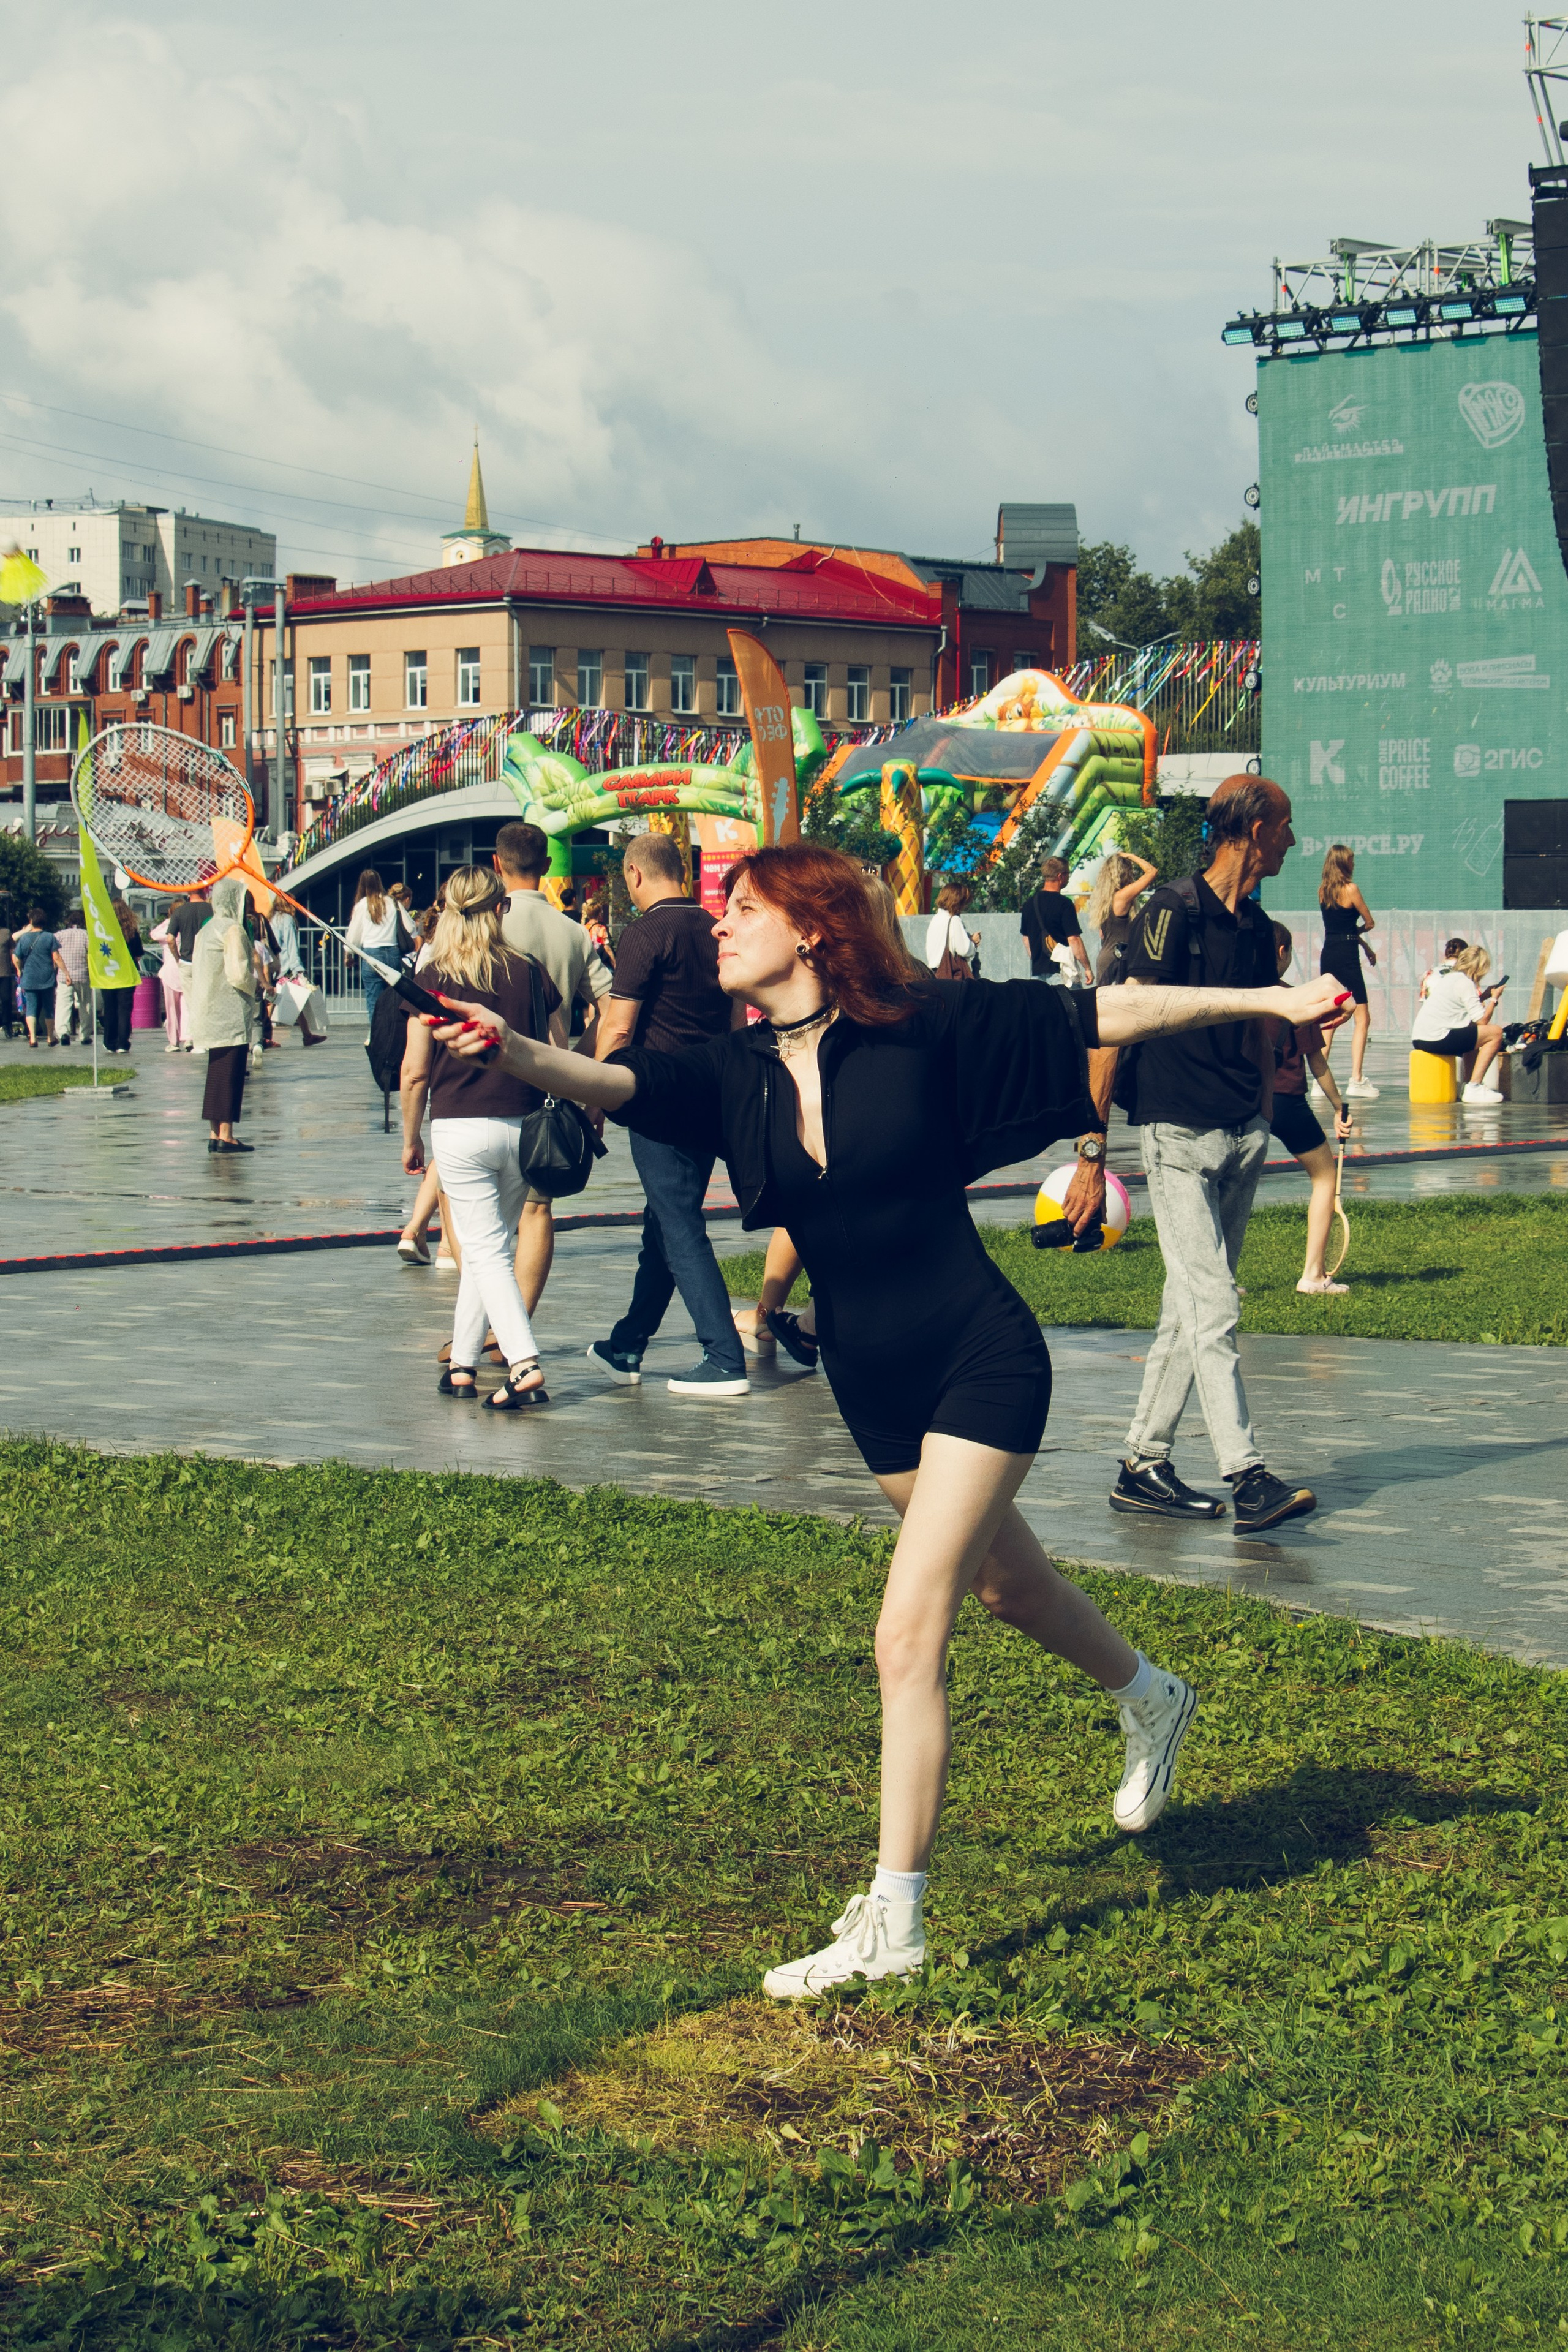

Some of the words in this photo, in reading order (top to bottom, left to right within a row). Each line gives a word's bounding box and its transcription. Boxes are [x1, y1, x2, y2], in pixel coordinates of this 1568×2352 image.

[1335, 484, 1497, 525] ИНГРУПП
[1405, 559, 1461, 586] РУССКОЕ
[1405, 587, 1447, 614] РАДИО
[1487, 597, 1545, 611] МАГМА
[1294, 672, 1406, 693] КУЛЬТУРИУМ
[1379, 739, 1388, 762] ONE
[1389, 737, 1431, 763] PRICE
[1485, 747, 1544, 770] 2ГИС
[602, 769, 693, 791] САФАРИ
[1379, 764, 1431, 790] COFFEE
[617, 788, 680, 809] ПАРК
[703, 864, 721, 873] чем
